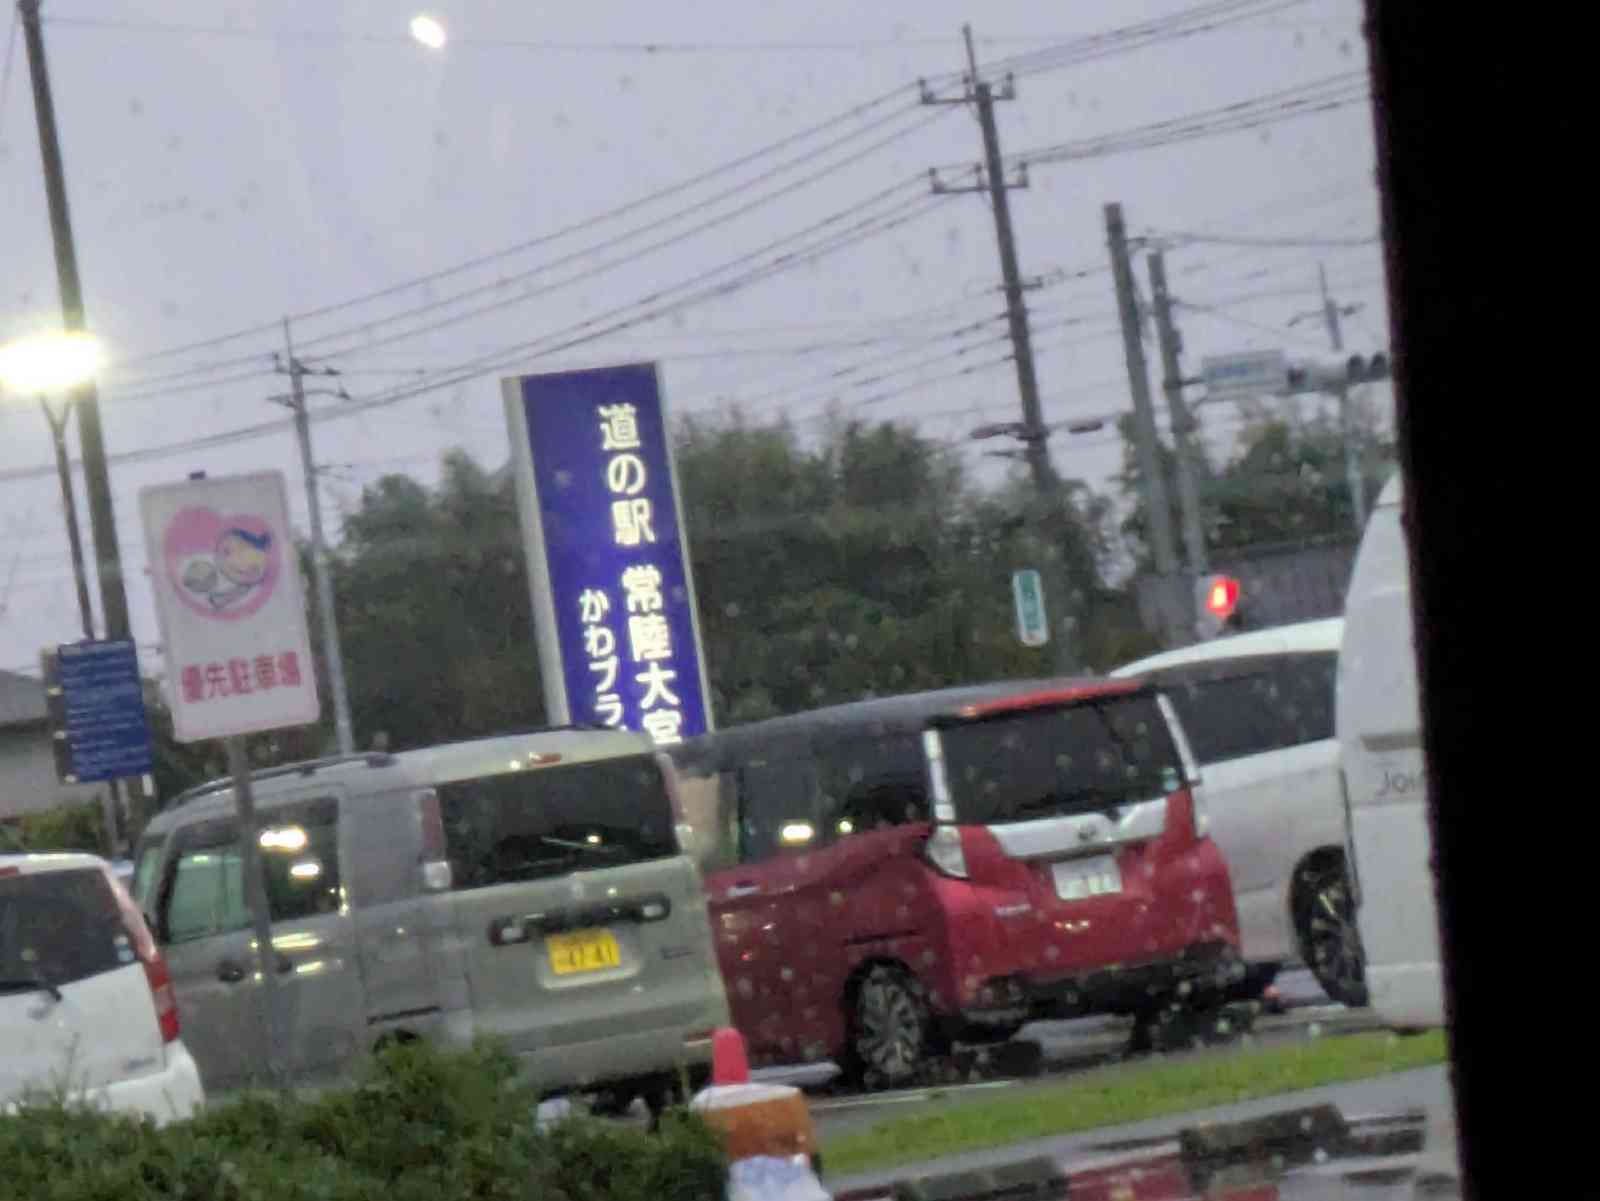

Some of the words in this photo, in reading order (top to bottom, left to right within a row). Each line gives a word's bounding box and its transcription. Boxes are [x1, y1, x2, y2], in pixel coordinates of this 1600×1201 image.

[597, 402, 656, 545] 道の駅
[621, 564, 684, 744] 常陸大宮
